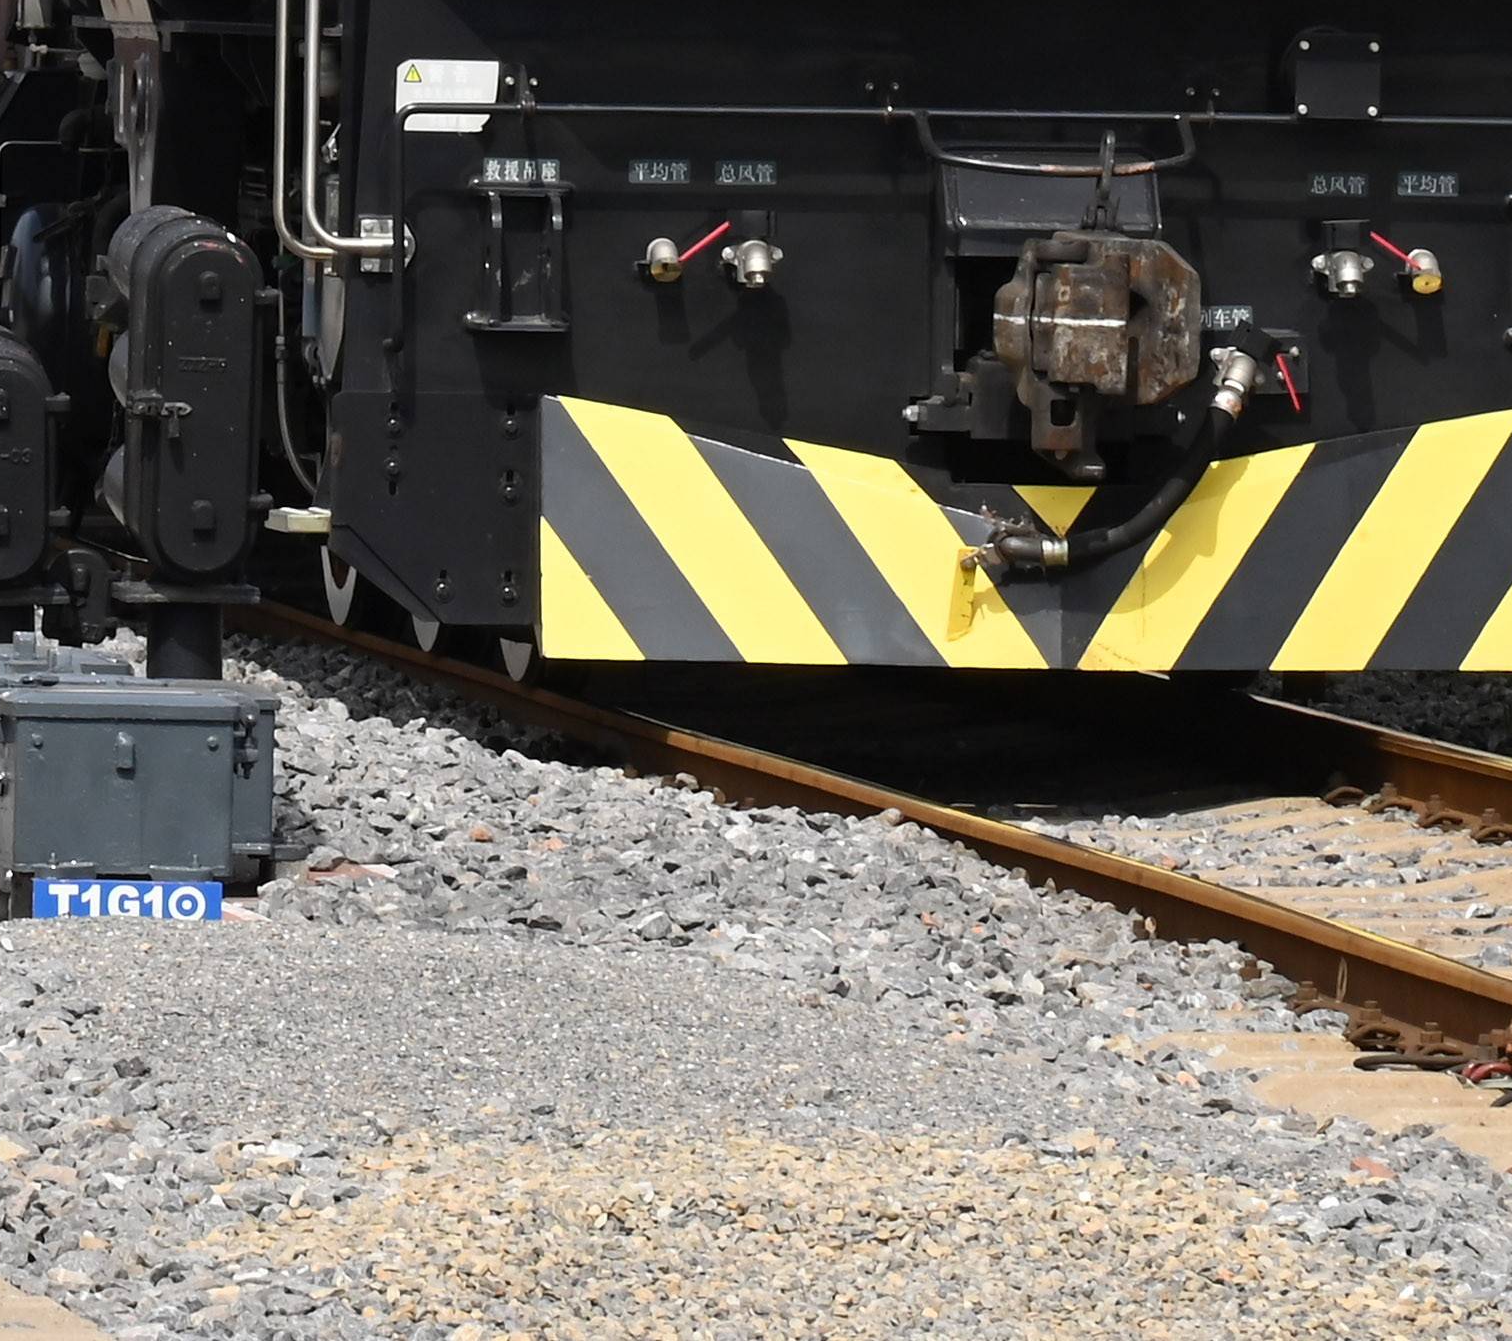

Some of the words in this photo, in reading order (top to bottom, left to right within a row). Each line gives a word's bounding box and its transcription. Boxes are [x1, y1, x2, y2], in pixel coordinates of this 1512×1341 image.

[485, 160, 557, 182] 救援吊座
[633, 162, 688, 182] 平均管
[719, 163, 773, 183] 总风管
[1311, 175, 1366, 195] 总风管
[1403, 175, 1456, 194] 平均管
